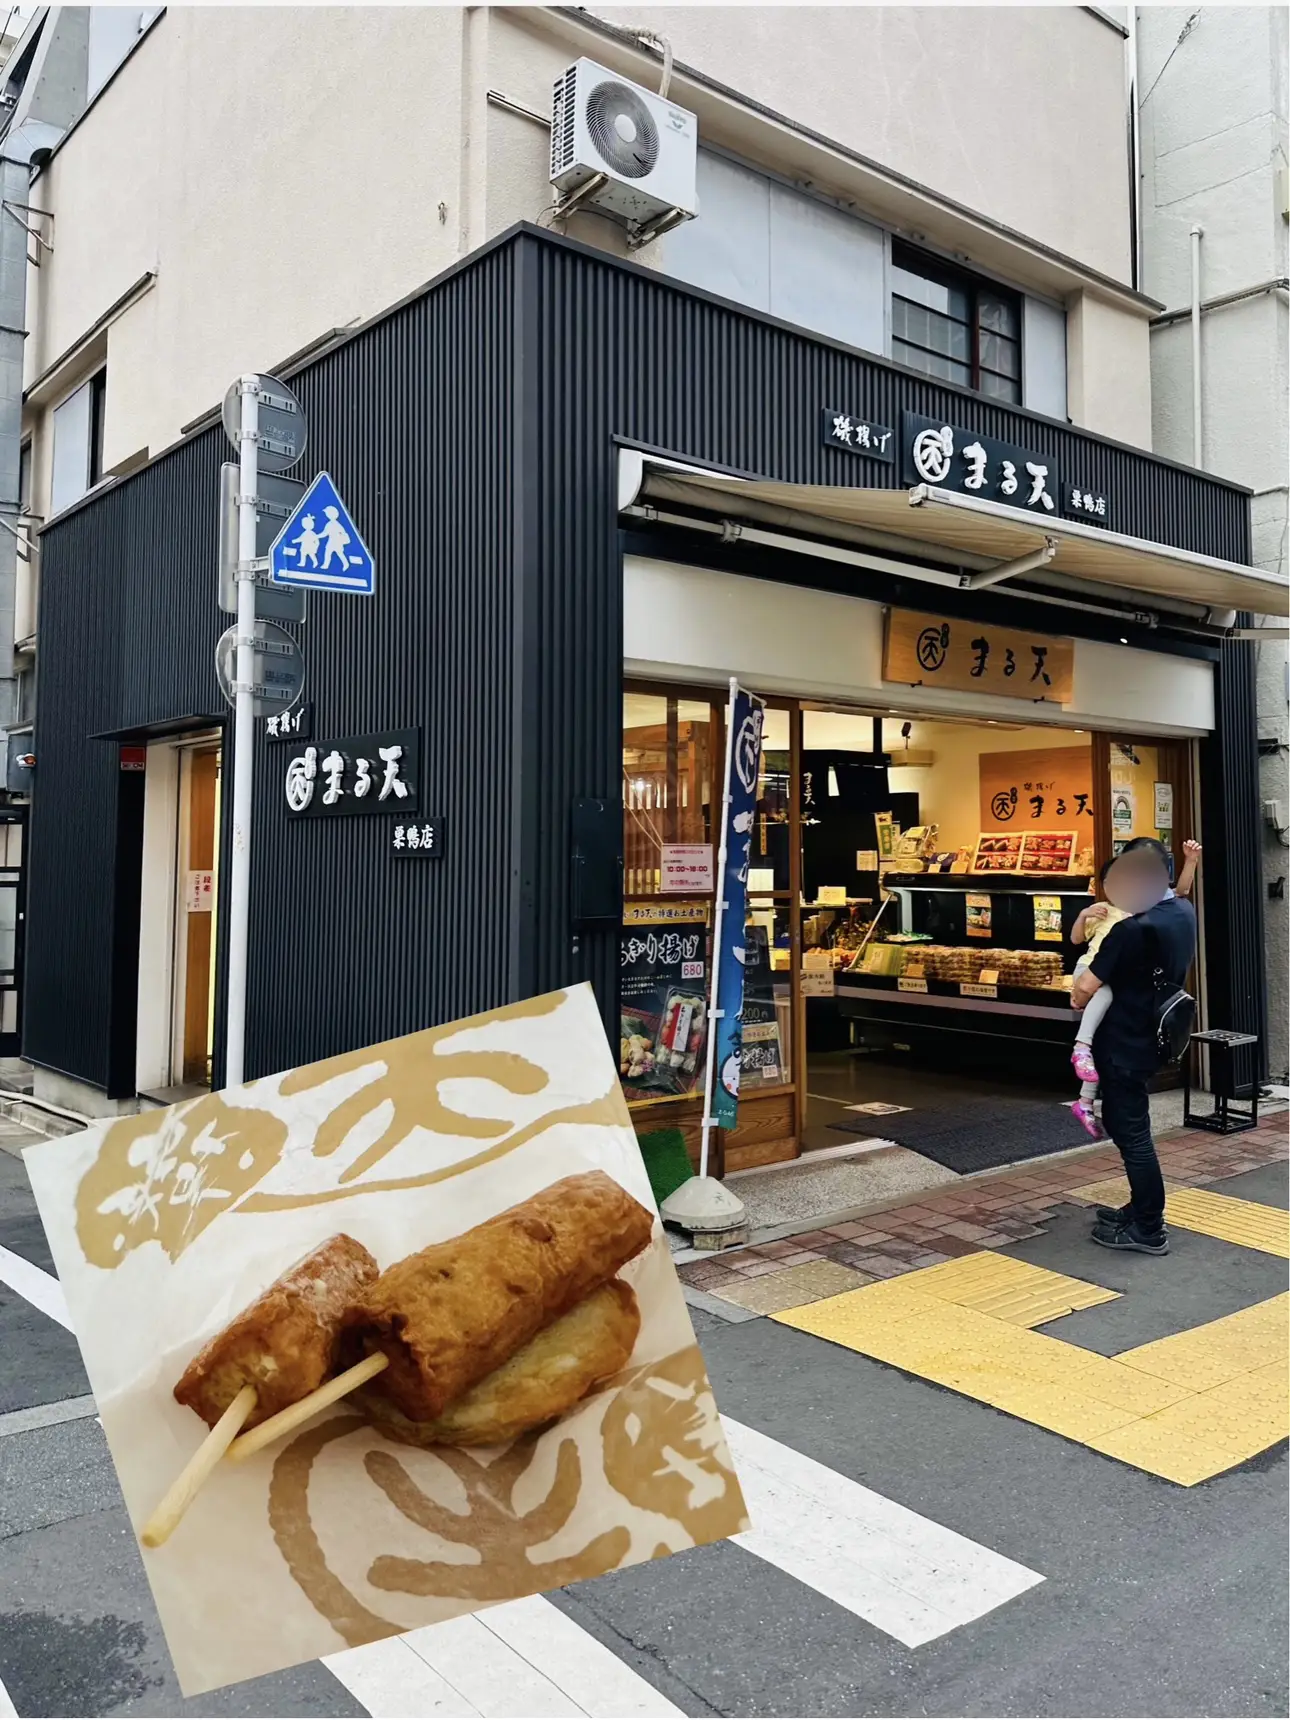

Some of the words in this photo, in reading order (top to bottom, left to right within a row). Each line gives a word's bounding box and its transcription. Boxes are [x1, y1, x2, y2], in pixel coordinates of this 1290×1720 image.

[832, 415, 892, 454] 磯揚げ
[962, 441, 1055, 511] まる天
[1071, 489, 1106, 516] 巣鴨店
[969, 636, 1052, 686] まる天
[322, 745, 408, 805] まる天
[1029, 794, 1095, 819] まる天
[392, 824, 434, 850] 巣鴨店
[683, 963, 702, 976] 680
